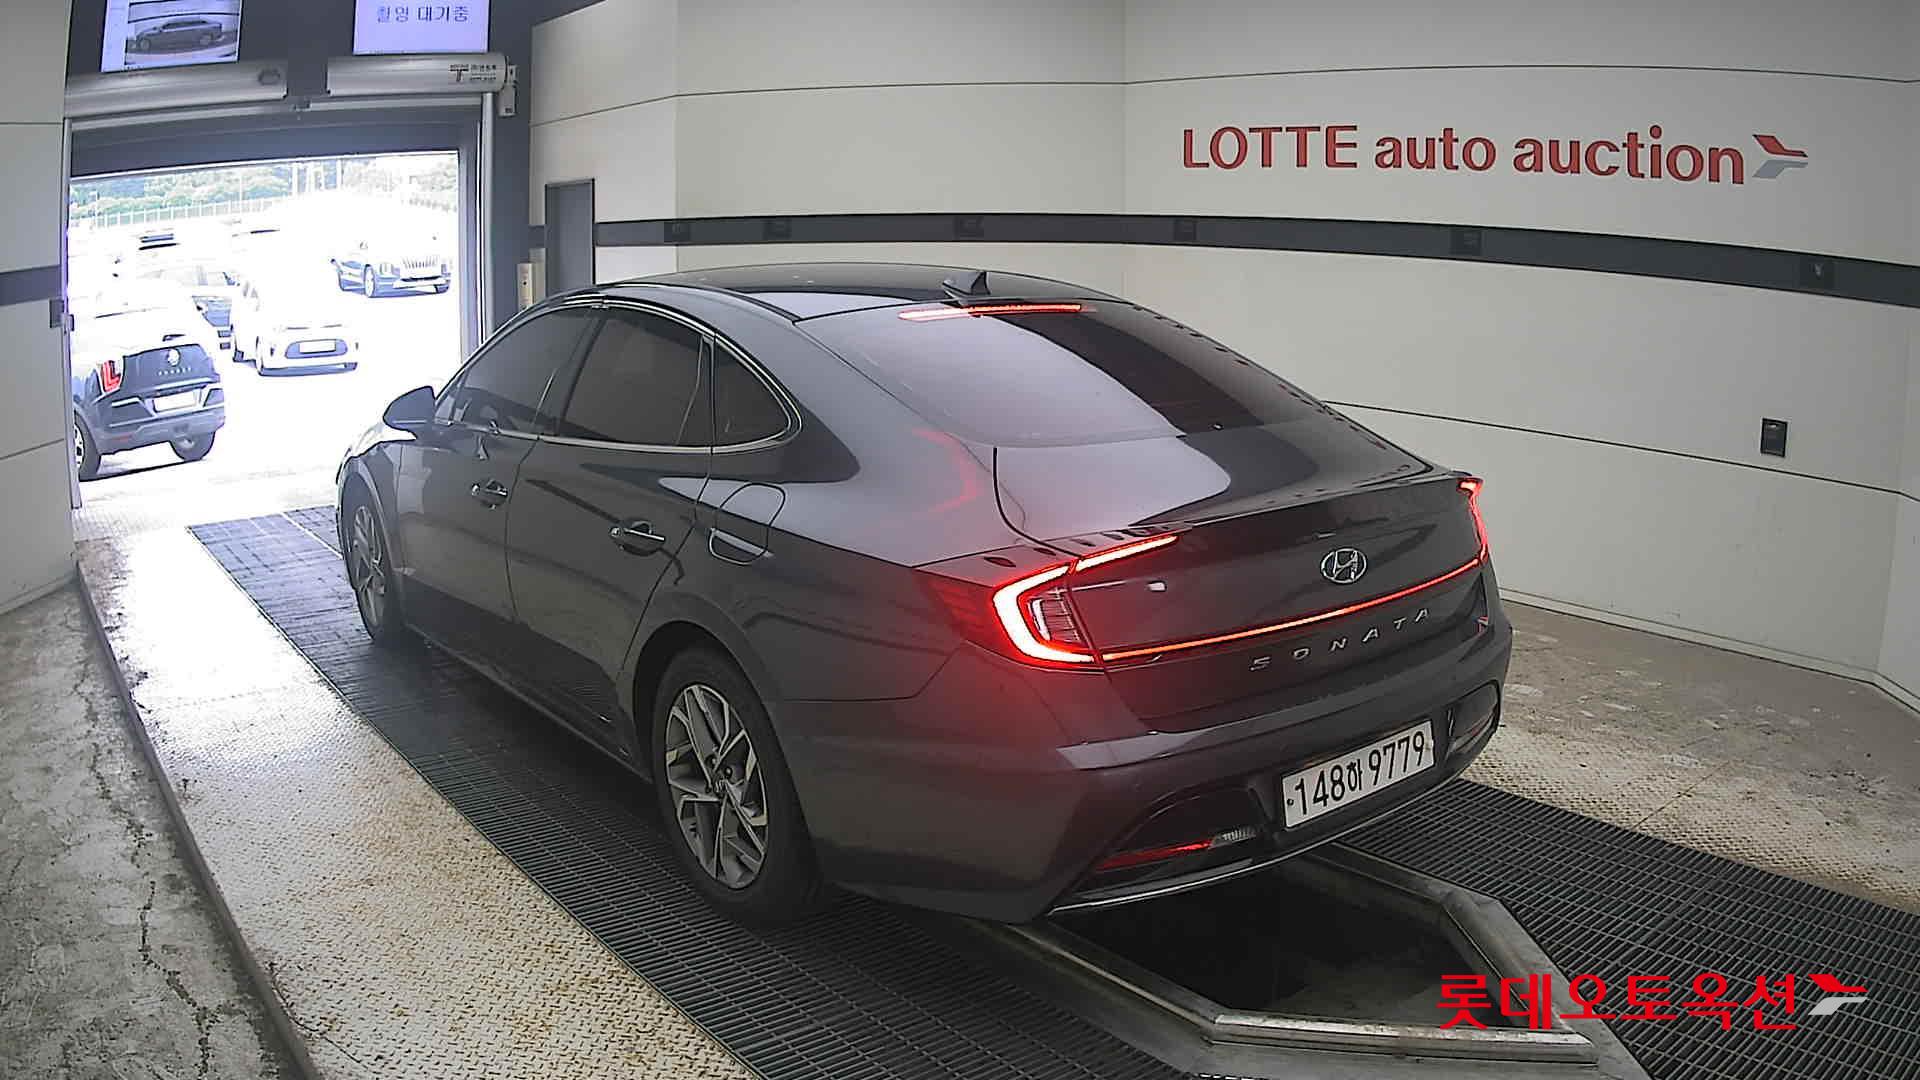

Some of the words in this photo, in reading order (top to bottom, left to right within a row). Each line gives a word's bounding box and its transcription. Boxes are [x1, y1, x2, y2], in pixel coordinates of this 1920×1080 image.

[417, 6, 471, 22] 대기중
[1183, 125, 1358, 169] LOTTE
[1374, 127, 1497, 171] auto
[1513, 125, 1745, 185] auction
[1250, 608, 1431, 671] SONATA
